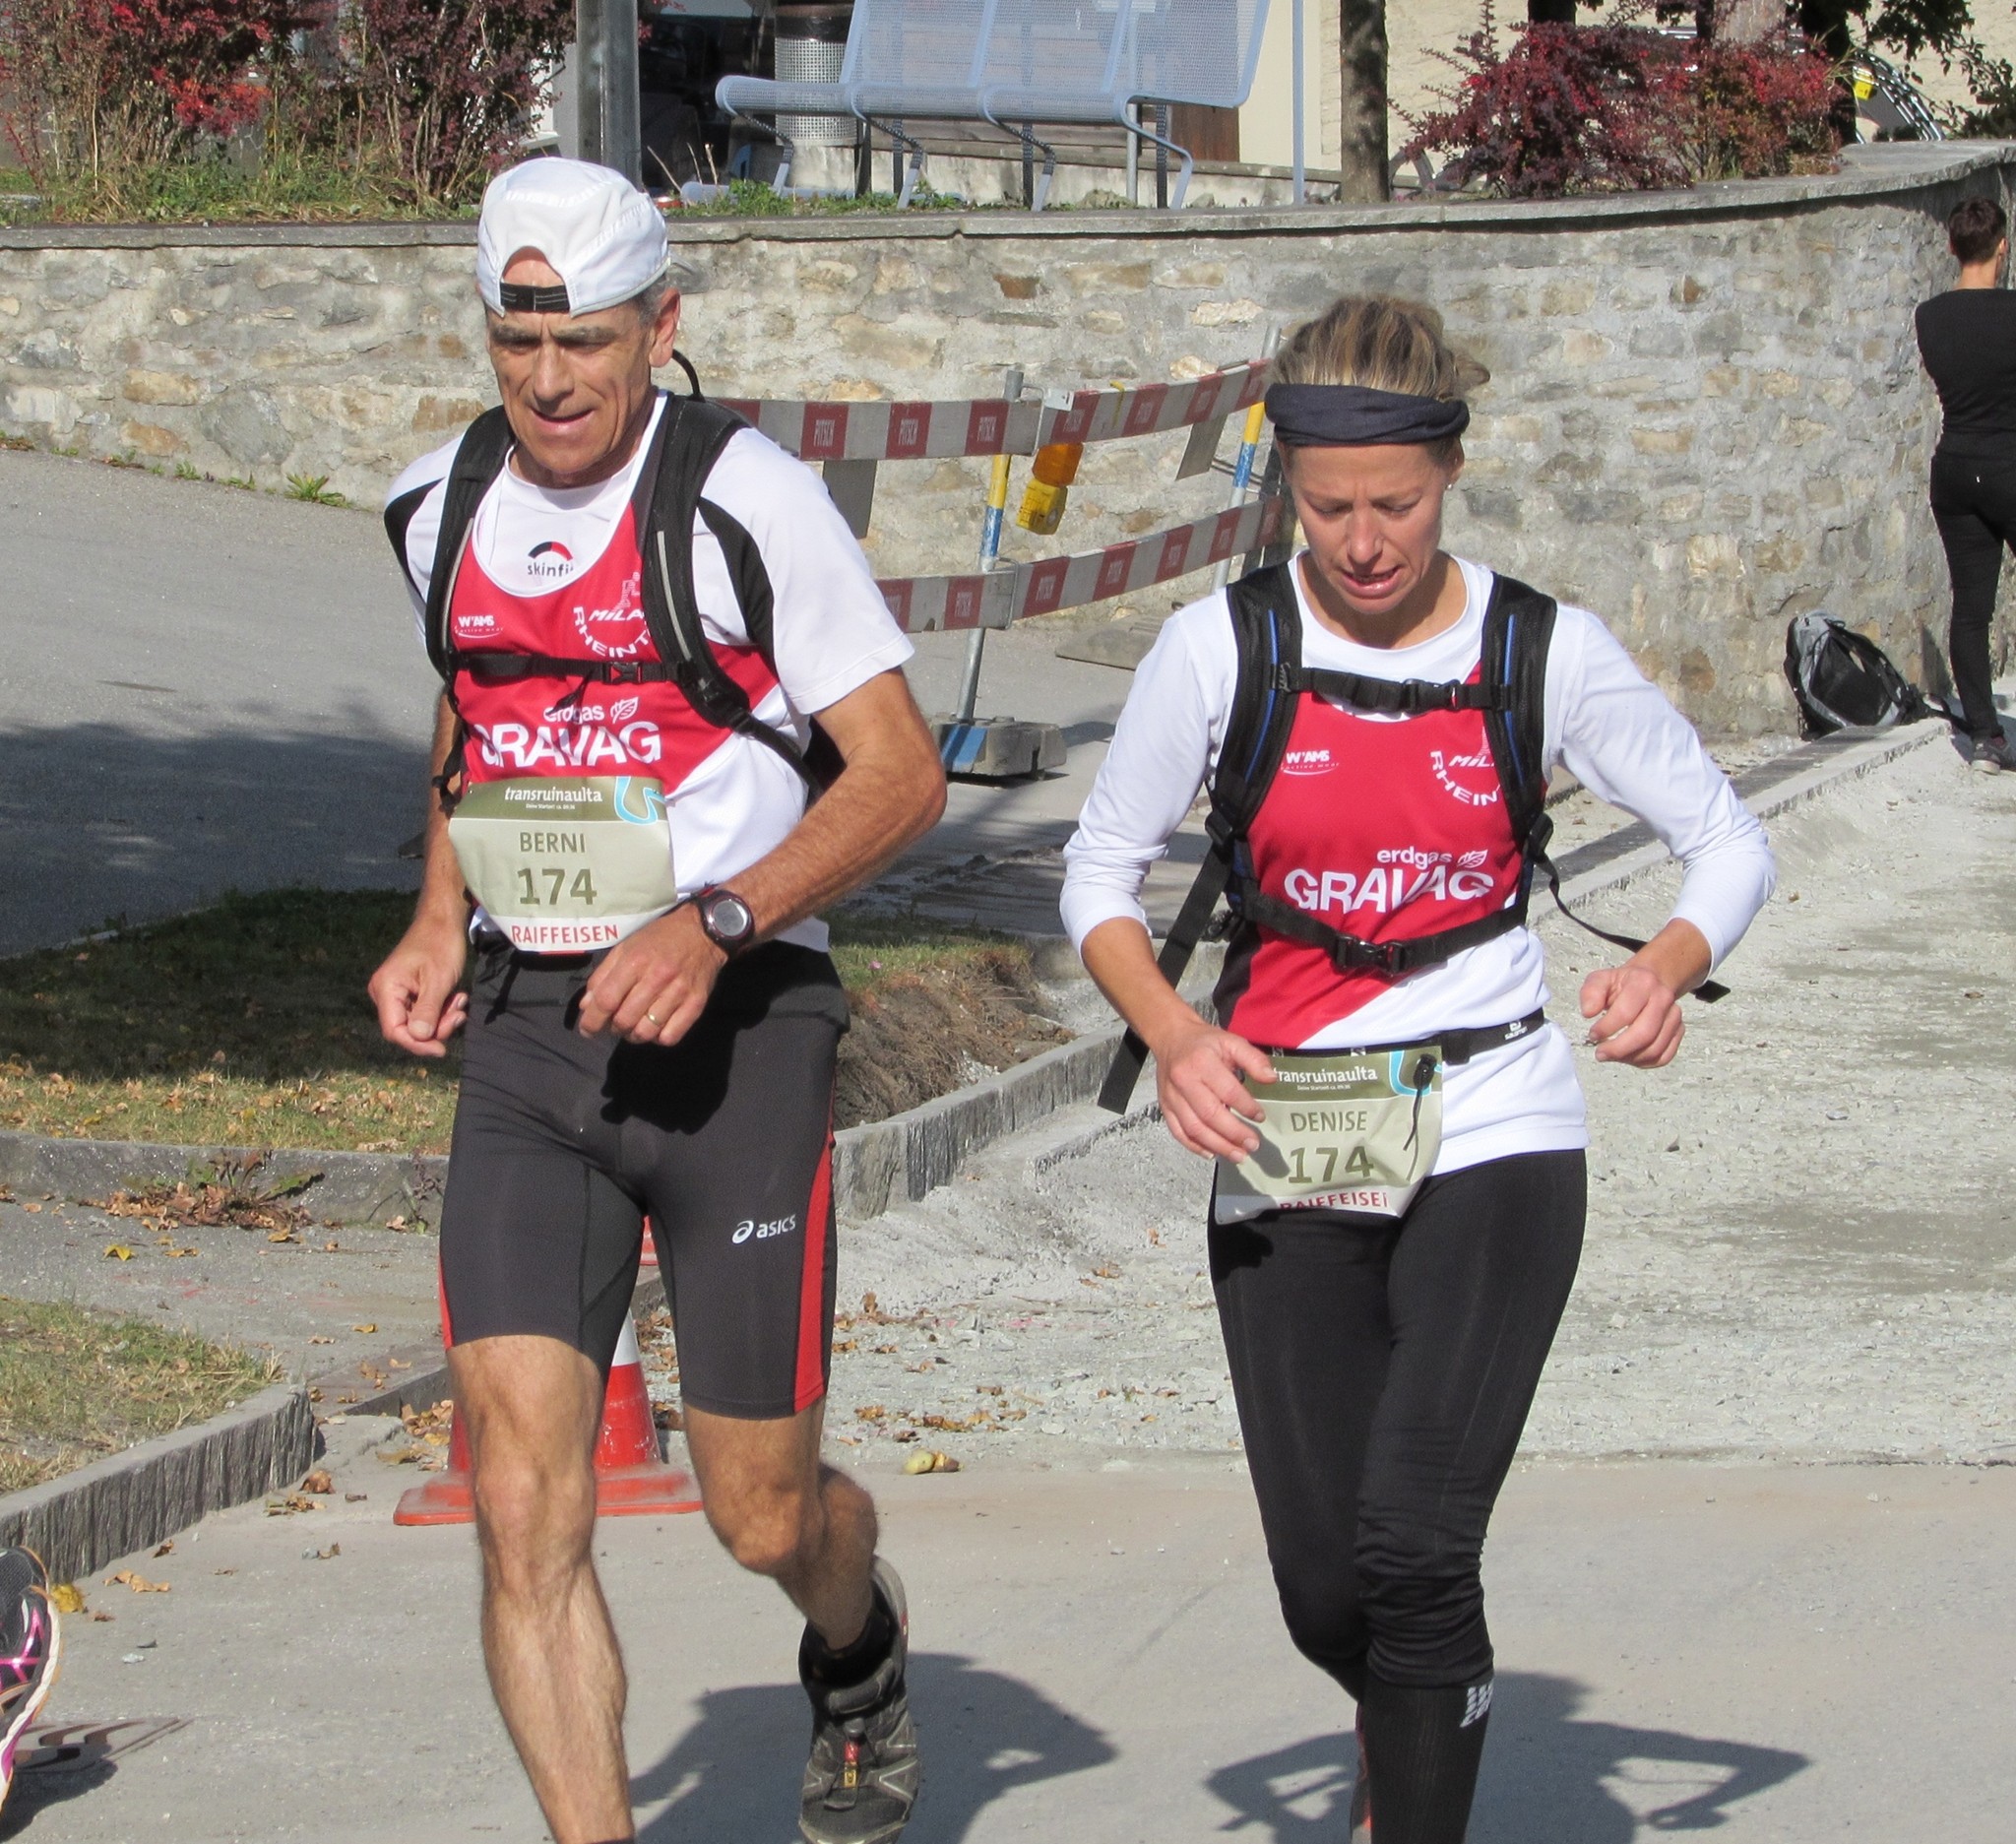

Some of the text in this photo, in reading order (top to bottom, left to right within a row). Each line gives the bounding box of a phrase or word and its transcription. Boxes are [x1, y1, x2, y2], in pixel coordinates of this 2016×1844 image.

[589, 609, 645, 621] MILA
[1430, 751, 1500, 806] RHEIN
[505, 786, 602, 802] transruinaulta
[520, 832, 586, 854] BERNI
[1377, 846, 1453, 869] erdgas
[518, 867, 598, 906] 174
[1285, 865, 1494, 915] GRAVAG
[512, 924, 619, 944] RAIFFEISEN
[1291, 1111, 1367, 1132] DENISE
[1289, 1146, 1374, 1183] 174
[756, 1214, 796, 1239] asics
